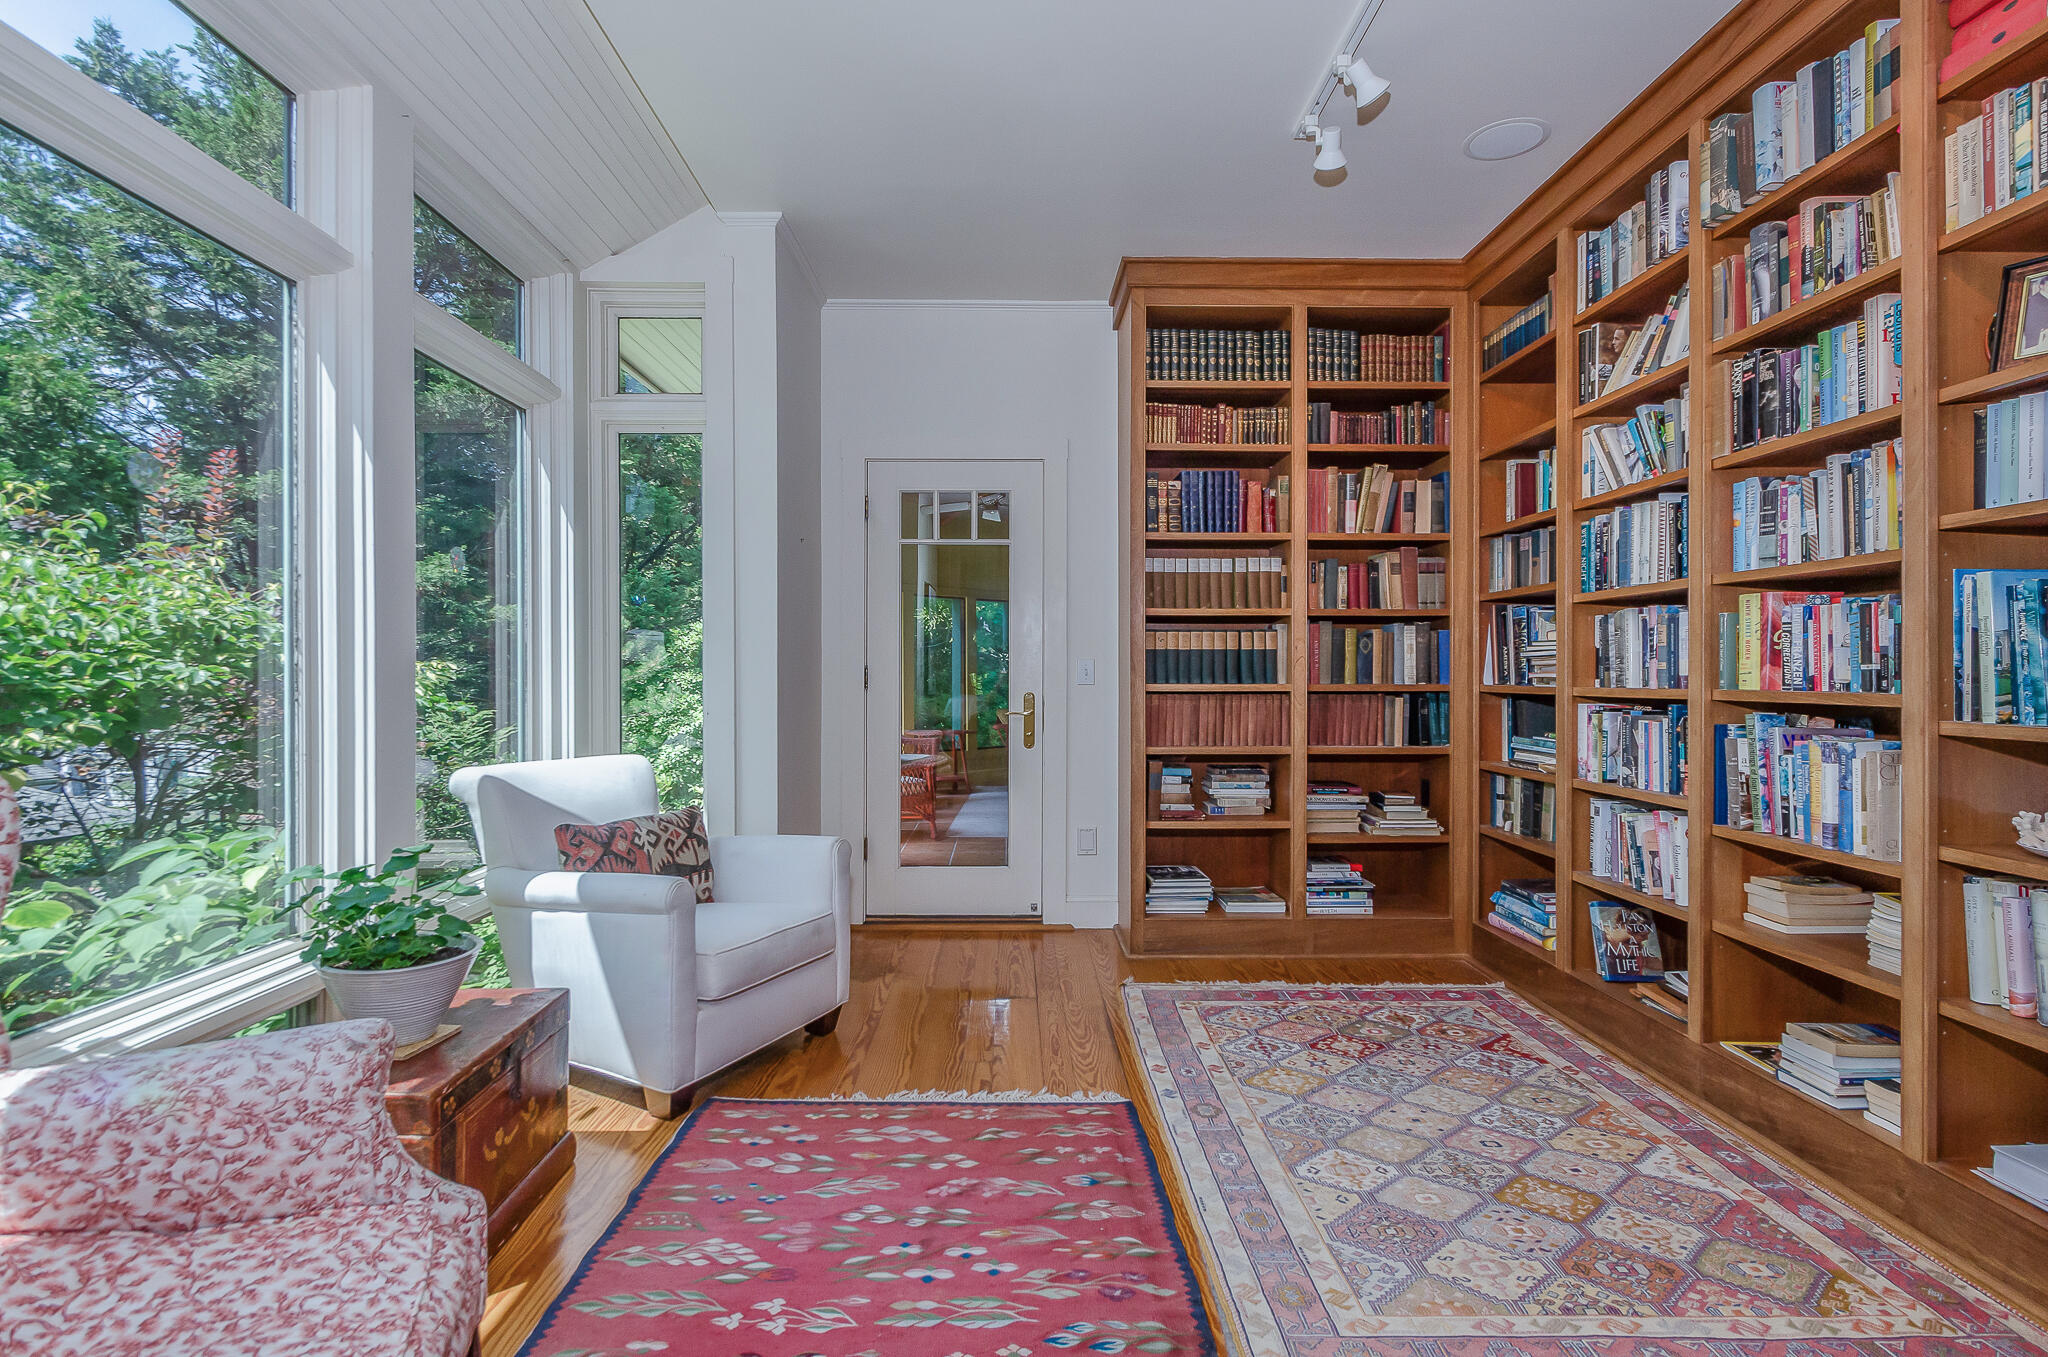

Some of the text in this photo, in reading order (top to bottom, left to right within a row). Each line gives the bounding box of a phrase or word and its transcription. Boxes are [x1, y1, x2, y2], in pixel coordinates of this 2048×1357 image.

[1970, 144, 1978, 165] Norton
[1969, 166, 1978, 198] Anthology
[1782, 632, 1792, 684] CORRECTIONS
[1793, 641, 1803, 685] FRANZEN
[1748, 737, 1758, 767] Paintings
[1752, 793, 1761, 820] Mitchell
[1599, 919, 1655, 934] HOUSTON
[1621, 909, 1644, 923] JEAN
[1616, 958, 1640, 974] LIFE
